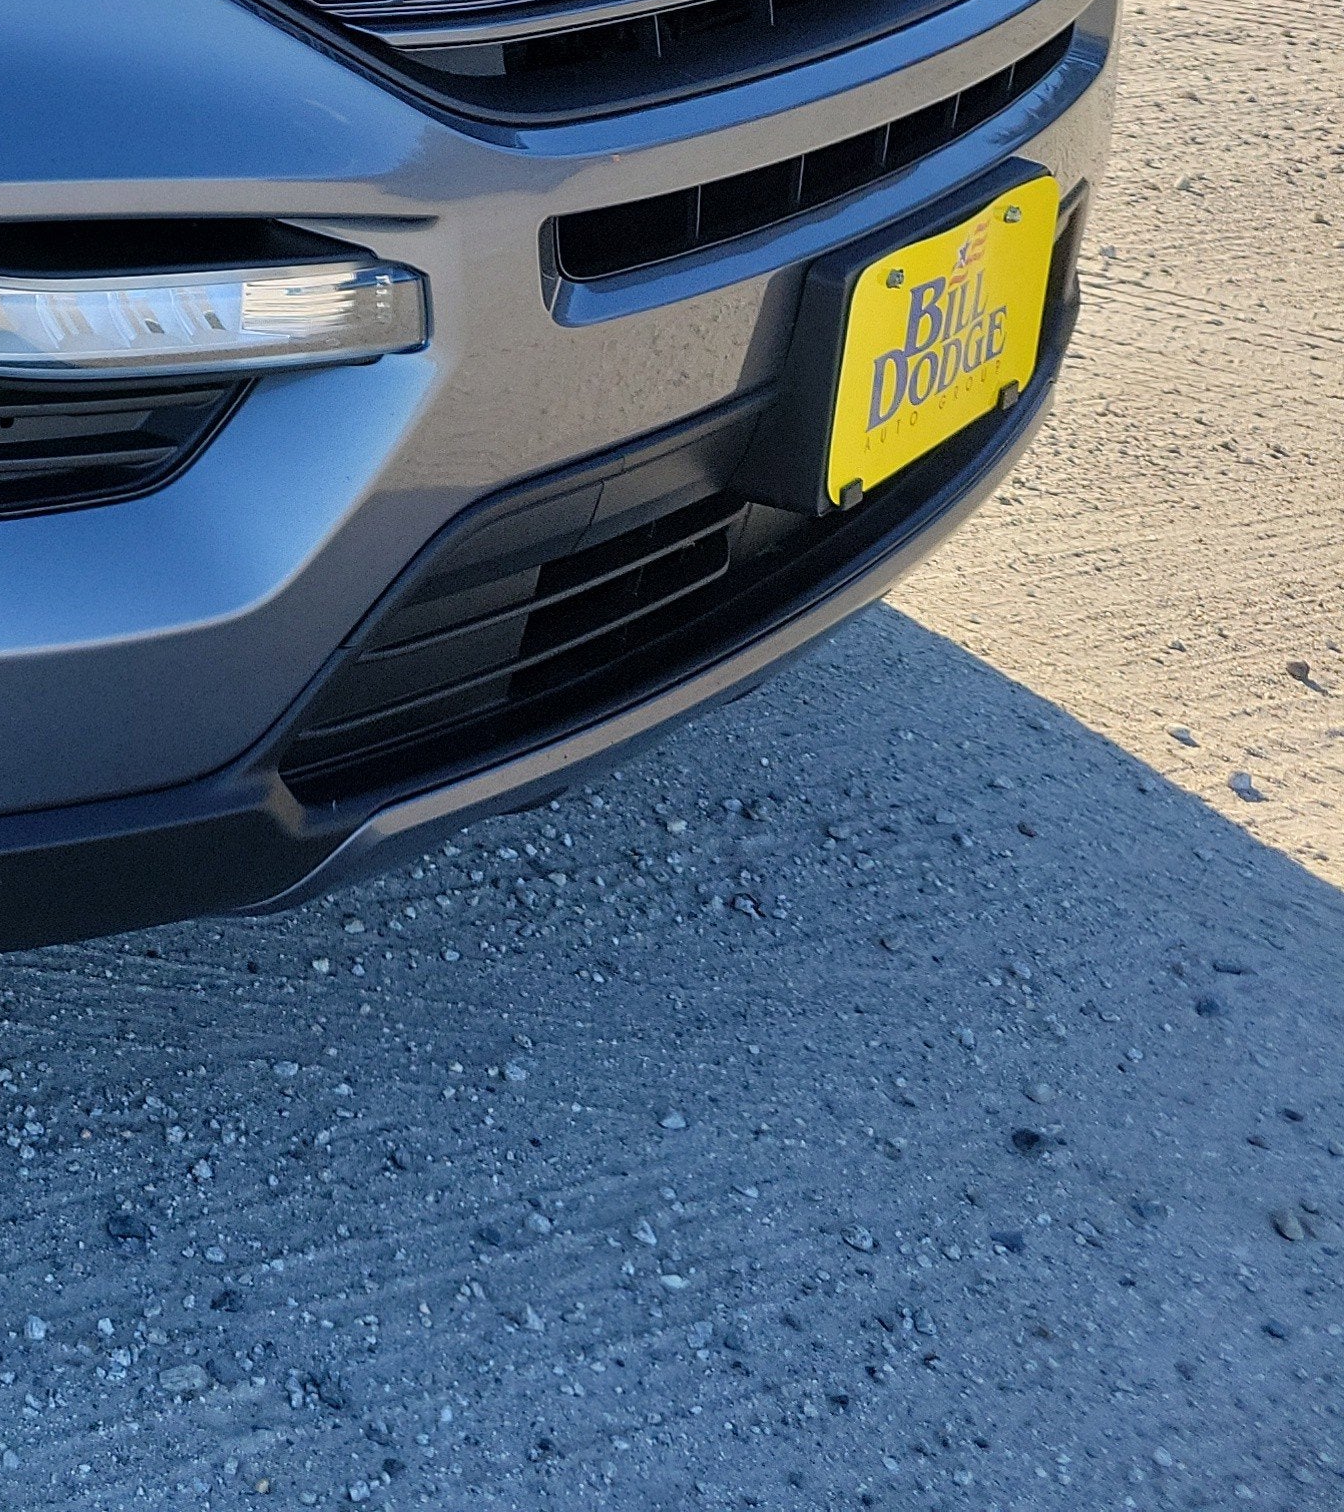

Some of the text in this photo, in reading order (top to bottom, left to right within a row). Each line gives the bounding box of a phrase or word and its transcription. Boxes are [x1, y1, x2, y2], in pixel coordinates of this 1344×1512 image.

[904, 272, 989, 359] BILL
[864, 358, 1002, 454] AUTO GROUP
[865, 305, 1009, 434] DODGE
